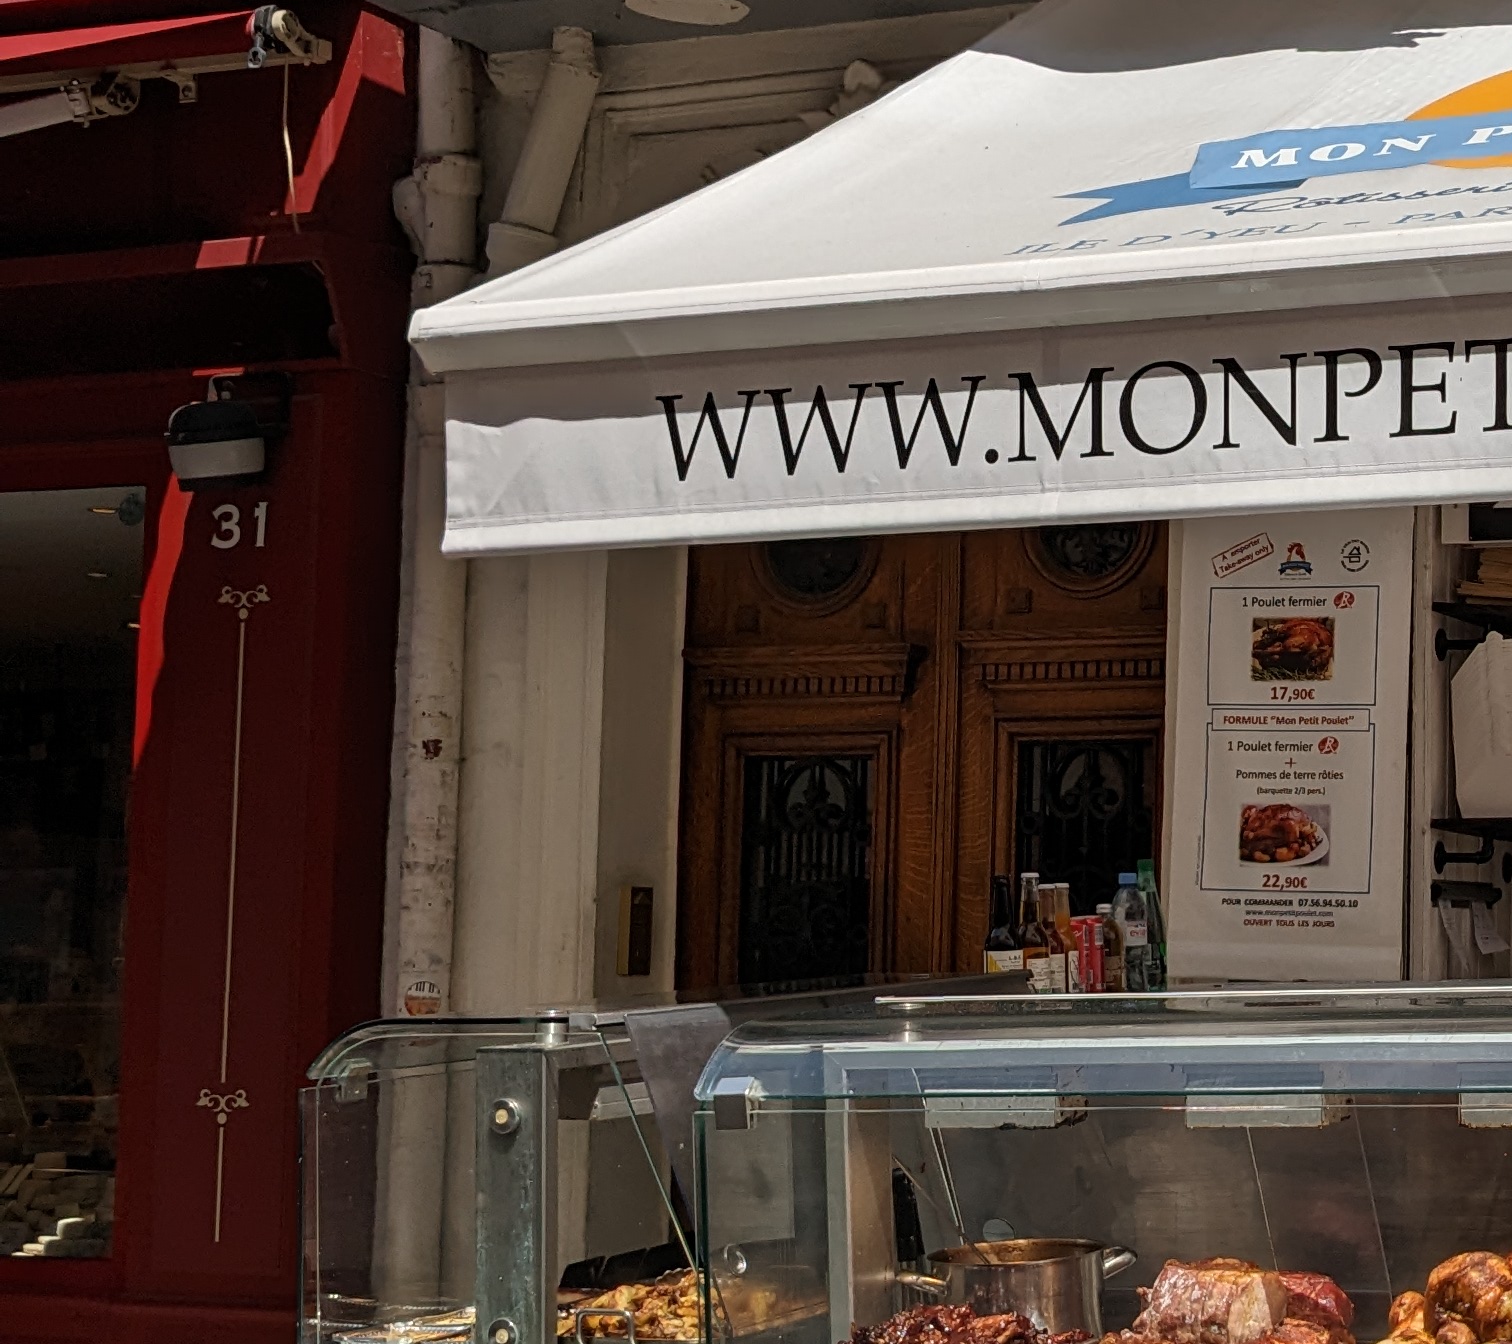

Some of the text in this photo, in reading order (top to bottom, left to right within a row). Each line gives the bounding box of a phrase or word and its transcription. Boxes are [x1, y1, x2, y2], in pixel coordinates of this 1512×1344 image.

[1230, 133, 1438, 169] MON
[1118, 220, 1323, 248] D'YEU
[211, 501, 269, 549] 31
[1255, 544, 1270, 557] only
[1242, 596, 1327, 607] 1 Poulet fermier
[1270, 686, 1316, 703] 17,90€
[1223, 715, 1268, 725] FORMULE
[1298, 716, 1320, 725] Petit
[1227, 740, 1313, 752] 1 Poulet fermier
[1236, 769, 1344, 780] Pommes de terre rôties
[1262, 874, 1308, 891] 22,90€
[1221, 898, 1242, 906] POUR
[1243, 919, 1273, 927] OUVERT
